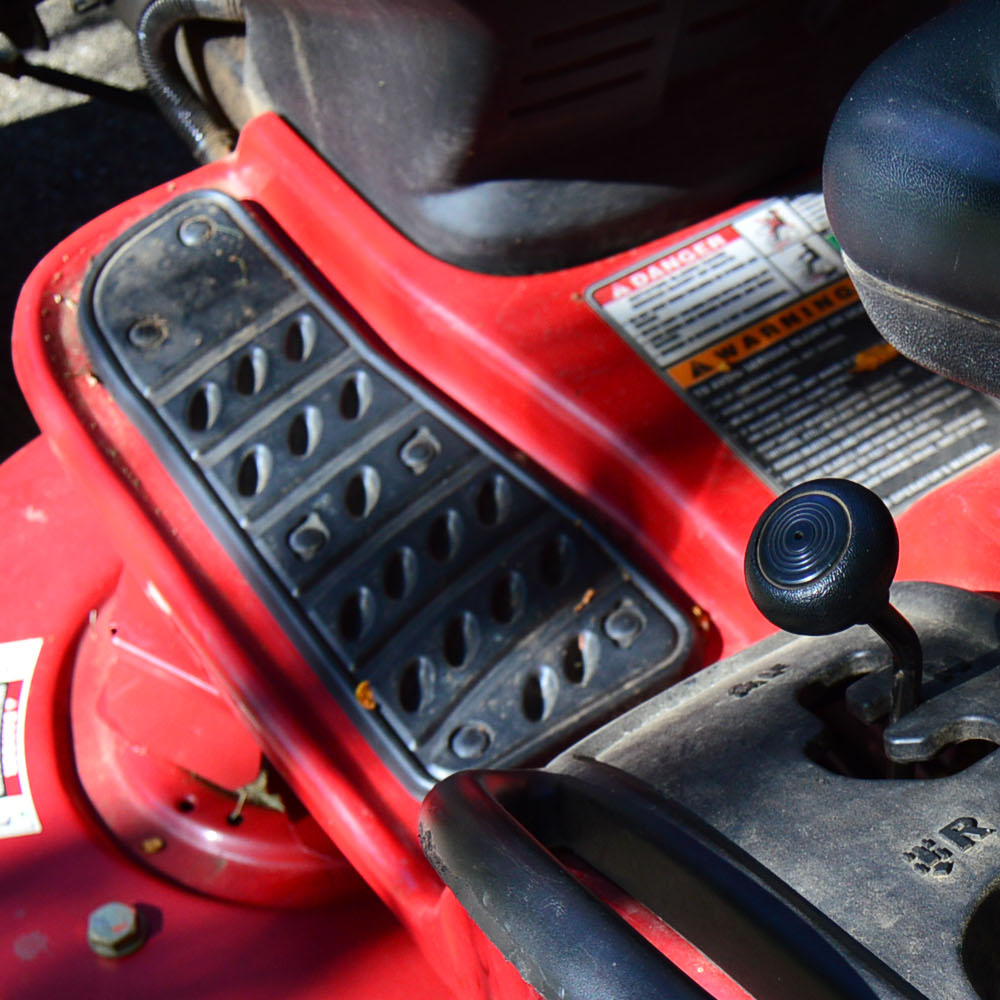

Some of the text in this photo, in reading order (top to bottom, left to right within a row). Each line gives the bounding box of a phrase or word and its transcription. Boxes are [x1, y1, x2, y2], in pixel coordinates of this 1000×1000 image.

[628, 232, 727, 289] DANGER
[713, 285, 853, 360] WARNING
[938, 816, 997, 851] R
